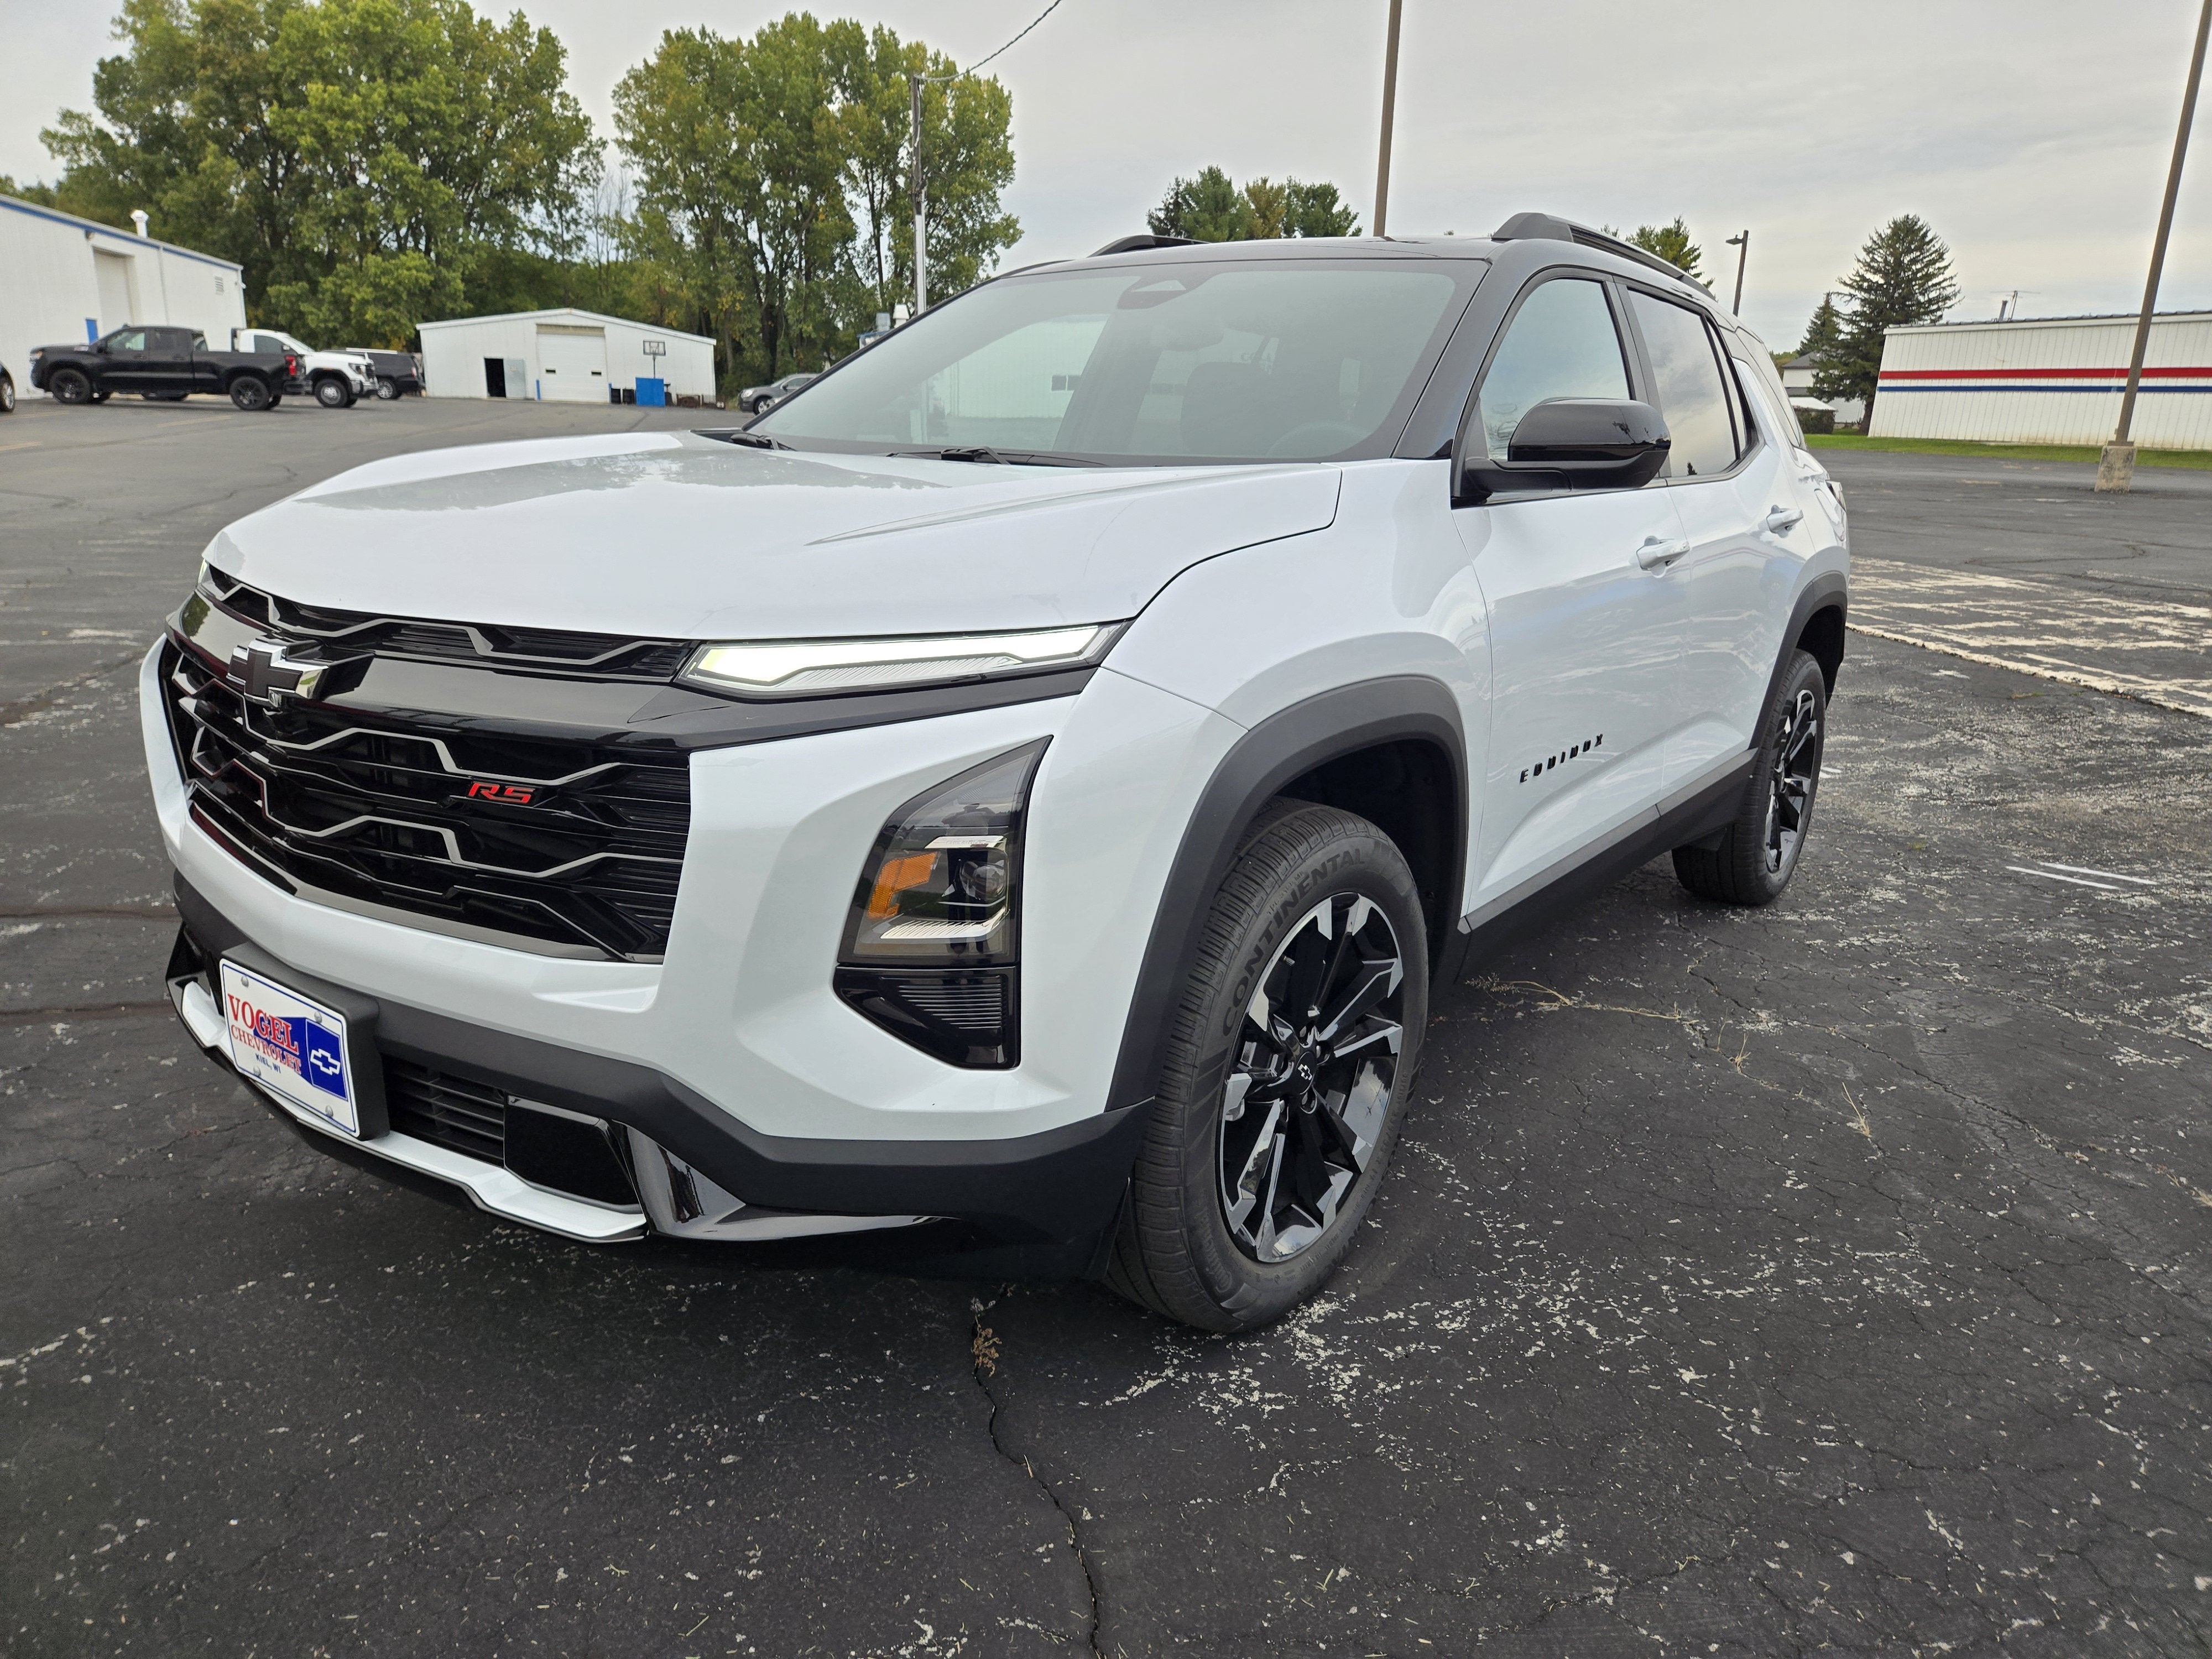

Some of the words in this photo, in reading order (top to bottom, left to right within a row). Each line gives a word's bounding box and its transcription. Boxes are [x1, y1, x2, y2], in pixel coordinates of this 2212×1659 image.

[1520, 733, 1603, 783] EQUINOX
[468, 781, 536, 804] RS
[1223, 848, 1365, 1036] CONTINENTAL
[227, 993, 299, 1055] VOGEL
[231, 1024, 301, 1075] CHEVROLET
[255, 1053, 272, 1070] KIEL,
[273, 1062, 281, 1074] WI
